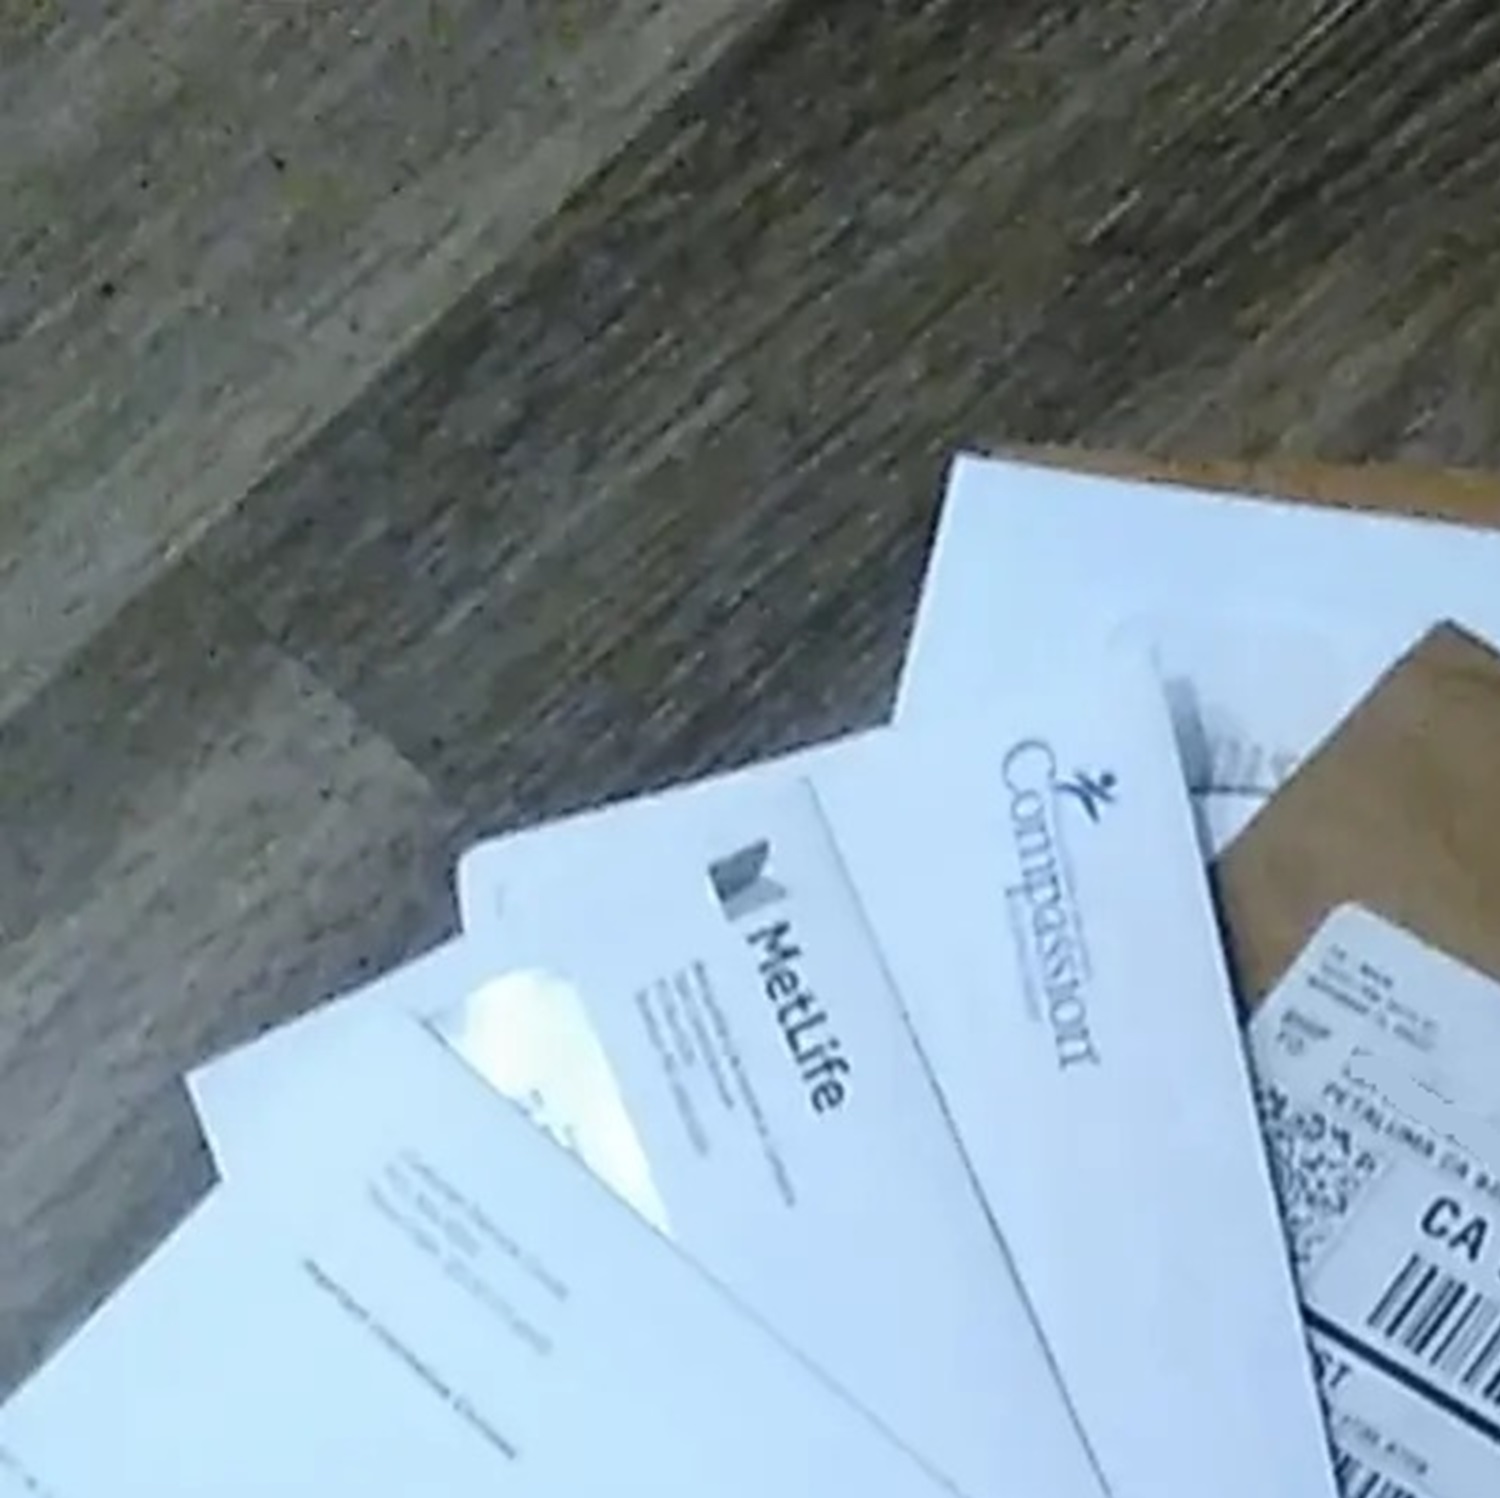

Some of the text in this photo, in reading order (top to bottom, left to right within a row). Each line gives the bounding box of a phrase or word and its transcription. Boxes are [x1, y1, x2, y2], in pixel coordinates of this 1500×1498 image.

[1001, 738, 1100, 1071] Compassion
[746, 920, 852, 1115] MetLife
[1419, 1196, 1490, 1262] CA
